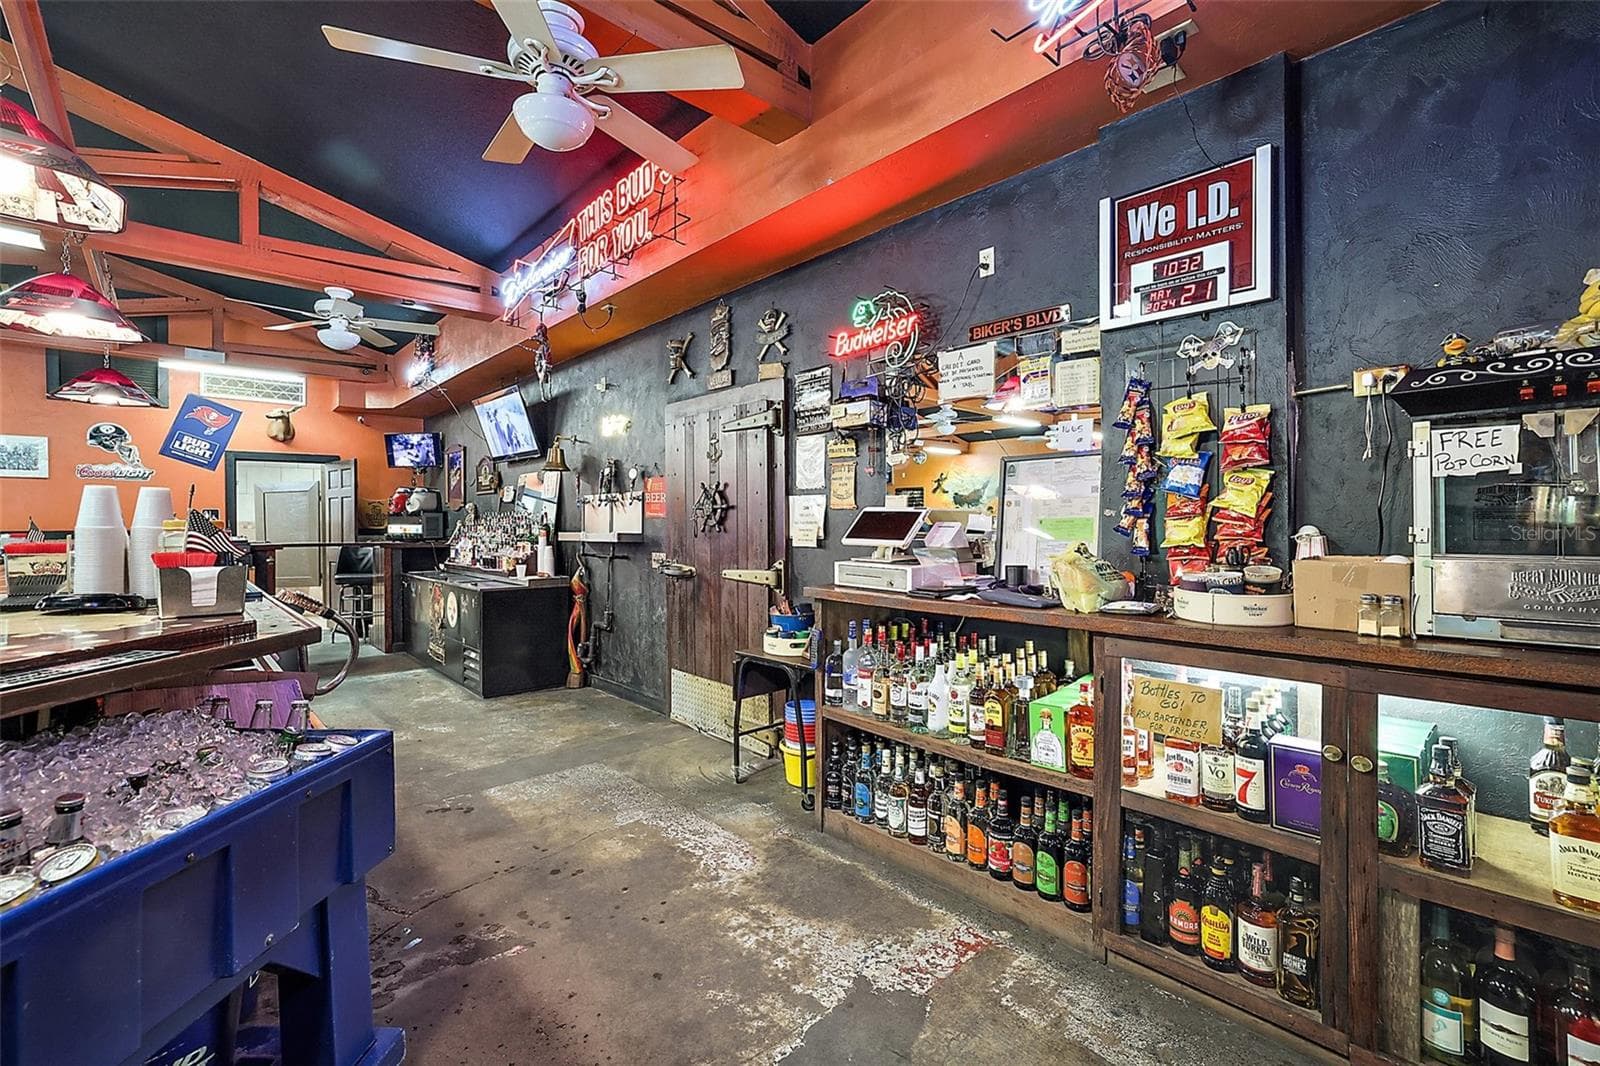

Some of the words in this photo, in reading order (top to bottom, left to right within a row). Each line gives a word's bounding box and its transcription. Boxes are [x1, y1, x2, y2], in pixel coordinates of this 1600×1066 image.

[577, 189, 613, 242] THIS
[1127, 201, 1176, 245] We
[1186, 181, 1240, 231] I.D.
[577, 234, 609, 278] FOR
[612, 208, 653, 257] YOU.
[1124, 235, 1194, 259] RESPONSIBILITY
[1150, 289, 1171, 301] MAY
[1145, 299, 1177, 313] 2024
[834, 313, 918, 357] Budweiser
[973, 317, 1022, 340] BIKER'S
[966, 358, 981, 366] CARD
[173, 440, 213, 460] LIGHT
[182, 434, 211, 450] BUD
[1440, 429, 1504, 453] FREE
[114, 468, 154, 480] LIGHT
[646, 493, 666, 503] BEER
[1191, 690, 1206, 704] TO
[1135, 709, 1151, 720] ASK
[1152, 712, 1207, 730] BARTENDER
[1149, 722, 1164, 732] FOR
[1169, 725, 1208, 740] PRICES!
[1177, 753, 1194, 766] BEAM
[1236, 767, 1257, 805] 7
[1421, 812, 1436, 821] JACK
[1437, 812, 1463, 830] DANIEL'S
[1559, 844, 1578, 854] JACK
[1242, 936, 1272, 956] TURKEY
[1246, 932, 1268, 947] WILD
